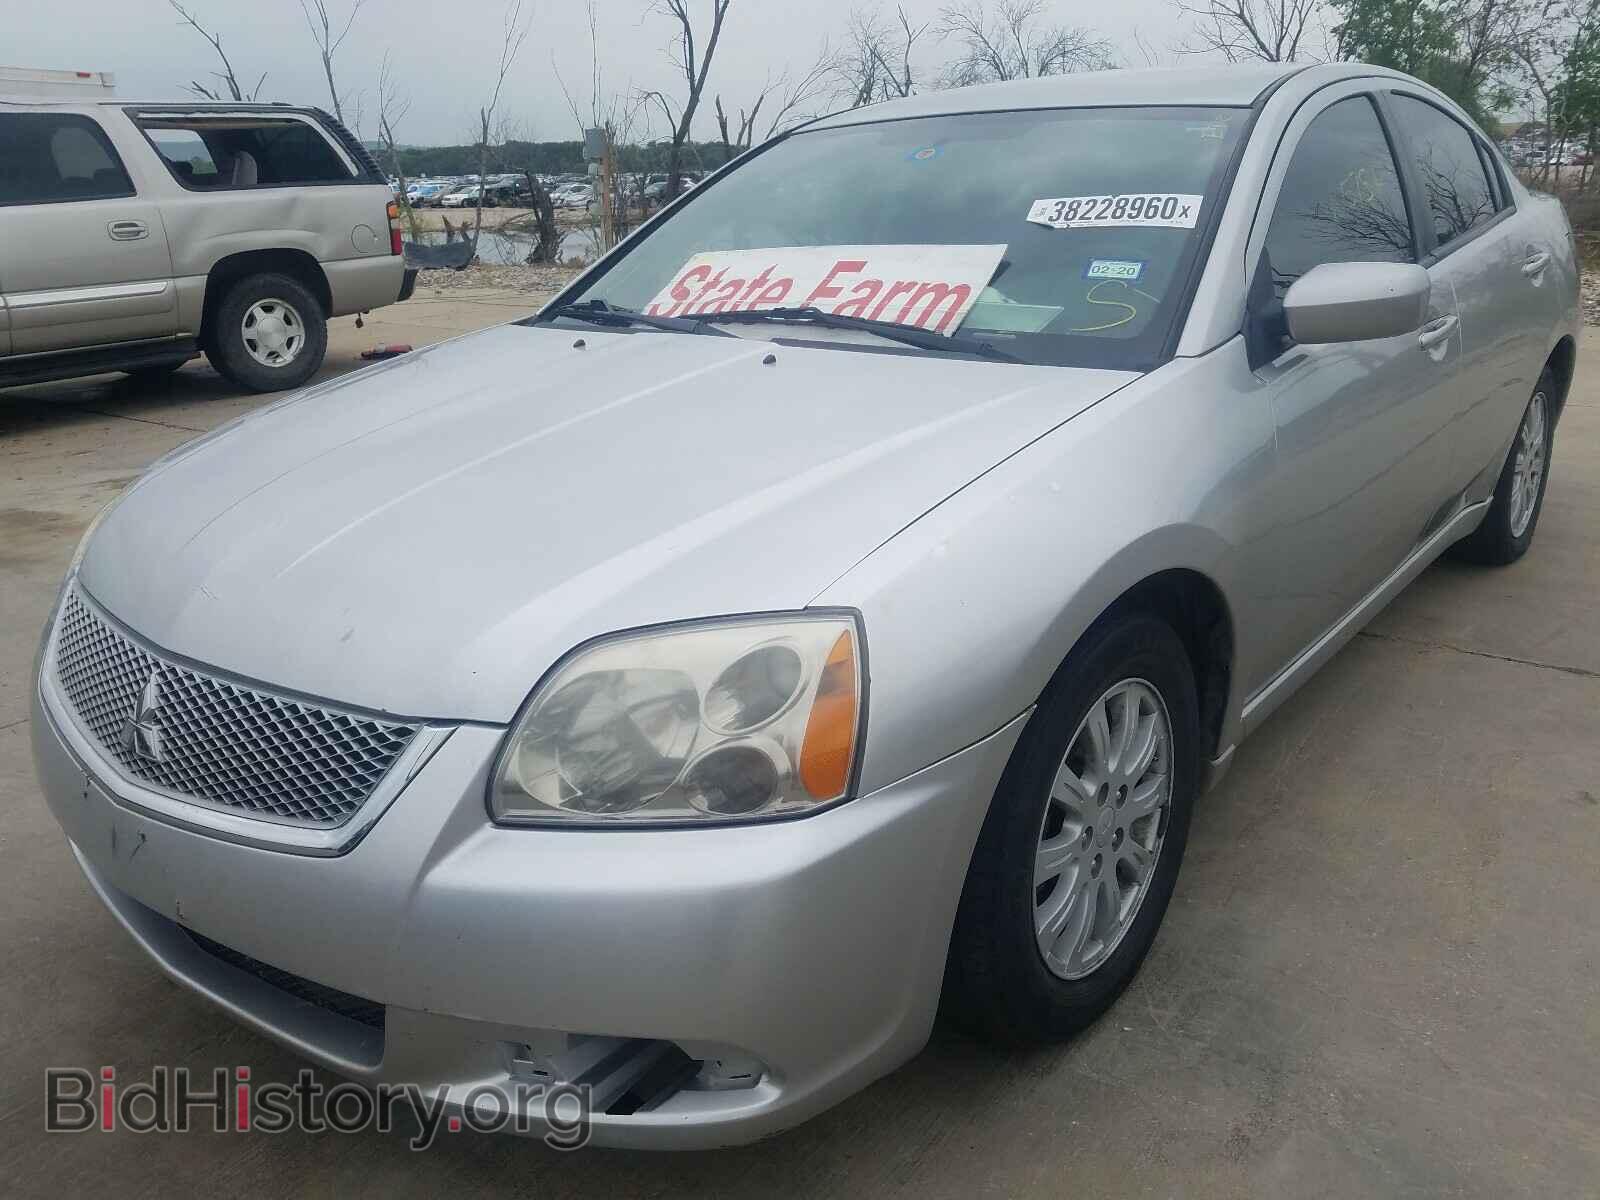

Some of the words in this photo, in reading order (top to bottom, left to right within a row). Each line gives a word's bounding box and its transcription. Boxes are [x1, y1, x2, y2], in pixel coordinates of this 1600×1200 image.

[1048, 196, 1179, 222] 38228960
[1091, 265, 1136, 276] 02-20
[648, 264, 793, 317] State
[800, 261, 972, 335] Farm
